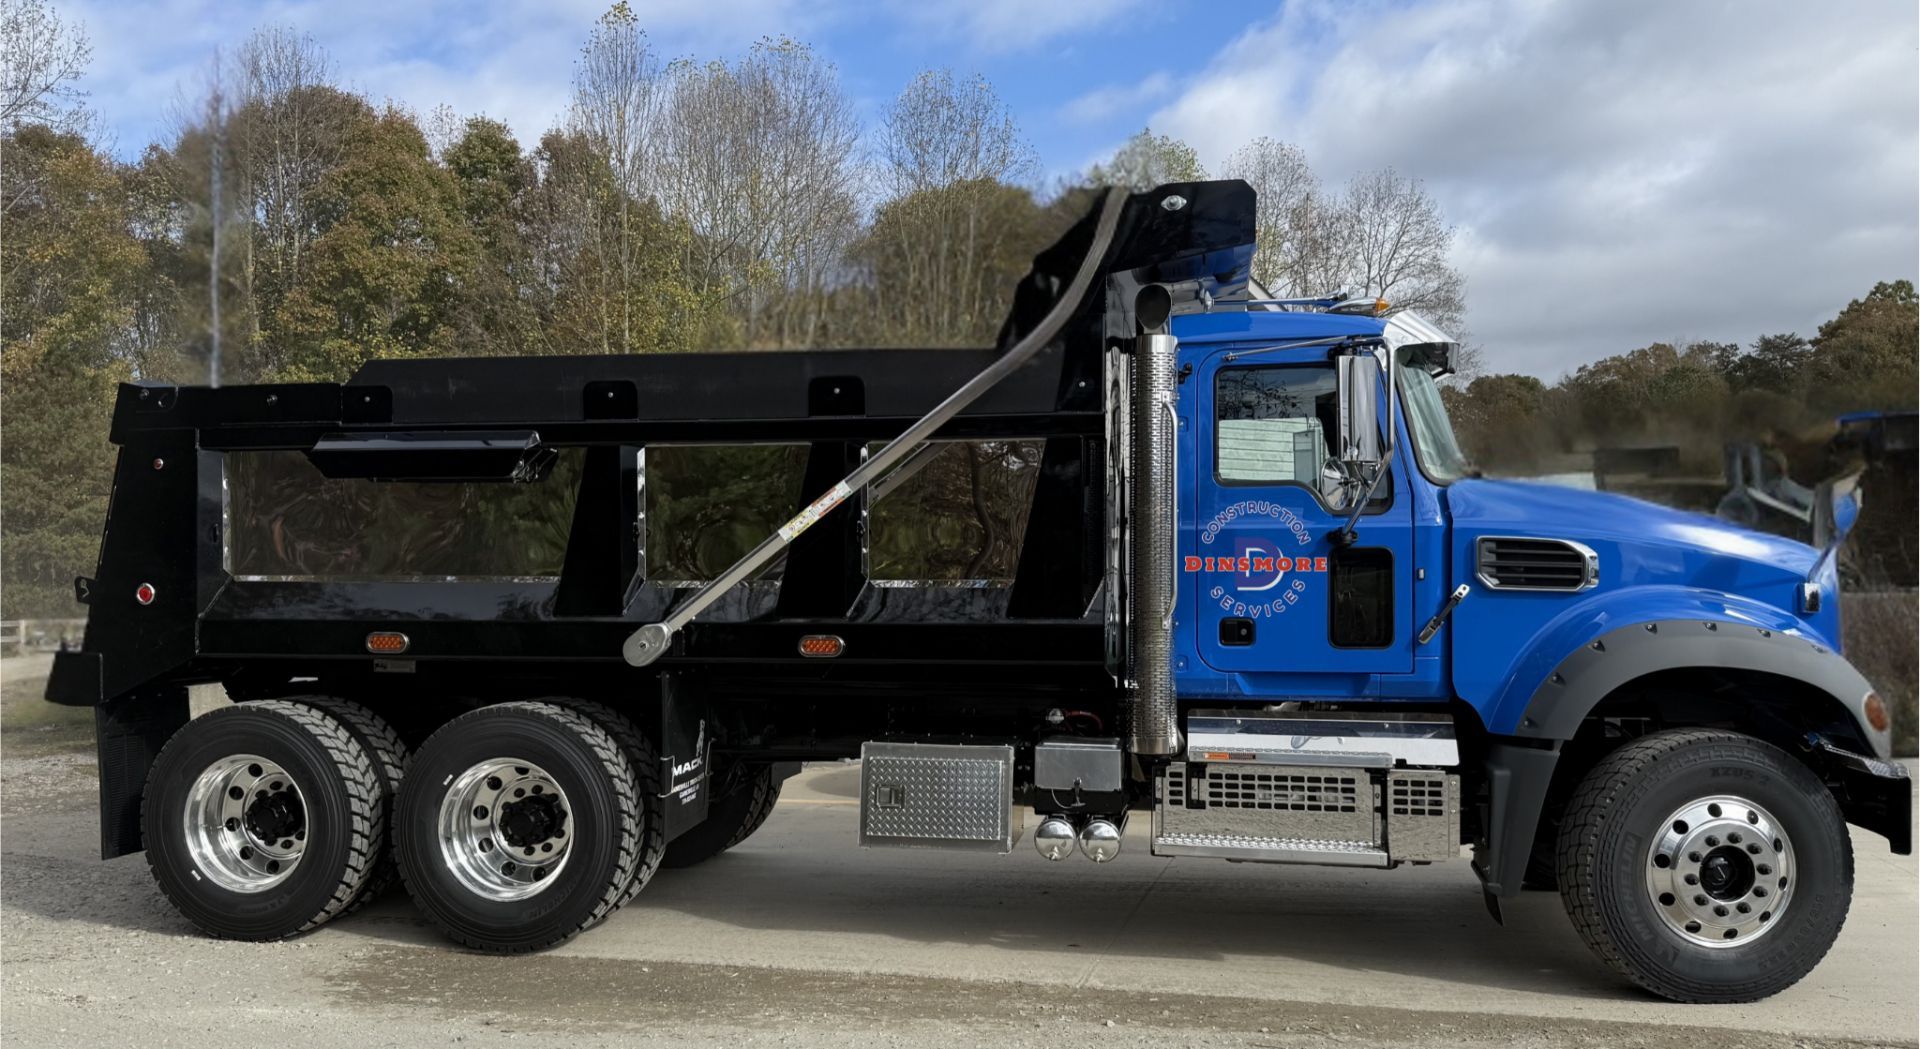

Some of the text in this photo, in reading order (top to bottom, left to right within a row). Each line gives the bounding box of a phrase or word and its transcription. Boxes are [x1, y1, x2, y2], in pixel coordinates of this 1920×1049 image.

[1202, 500, 1311, 545] CONSTRUCTION
[1185, 556, 1328, 572] DINSMORE
[1211, 579, 1306, 618] SERVICES
